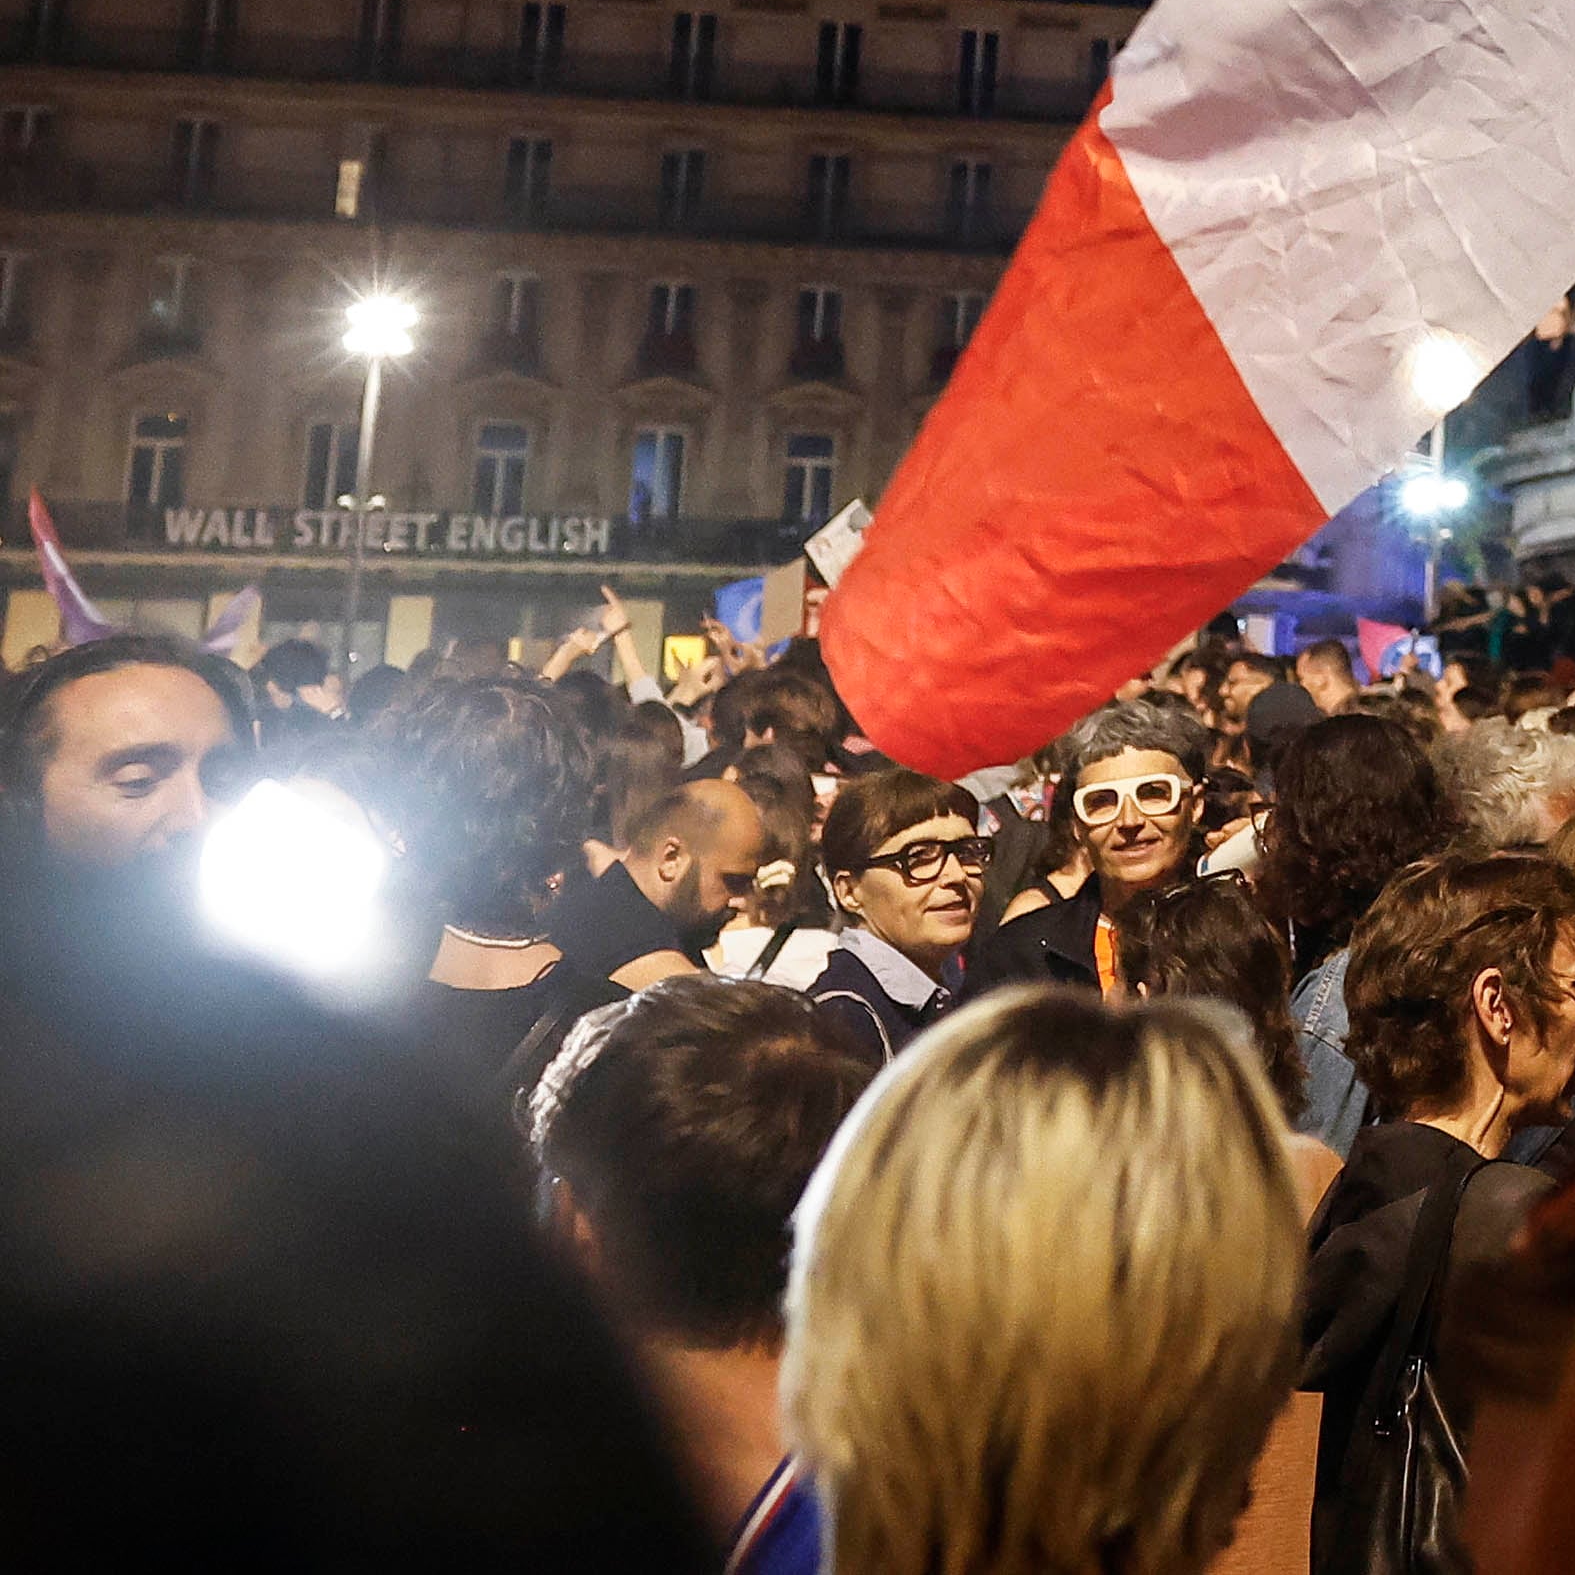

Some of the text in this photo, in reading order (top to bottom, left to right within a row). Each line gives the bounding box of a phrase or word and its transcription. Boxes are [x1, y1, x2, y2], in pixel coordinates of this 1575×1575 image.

[164, 508, 611, 555] WALL STREET ENGLISH
